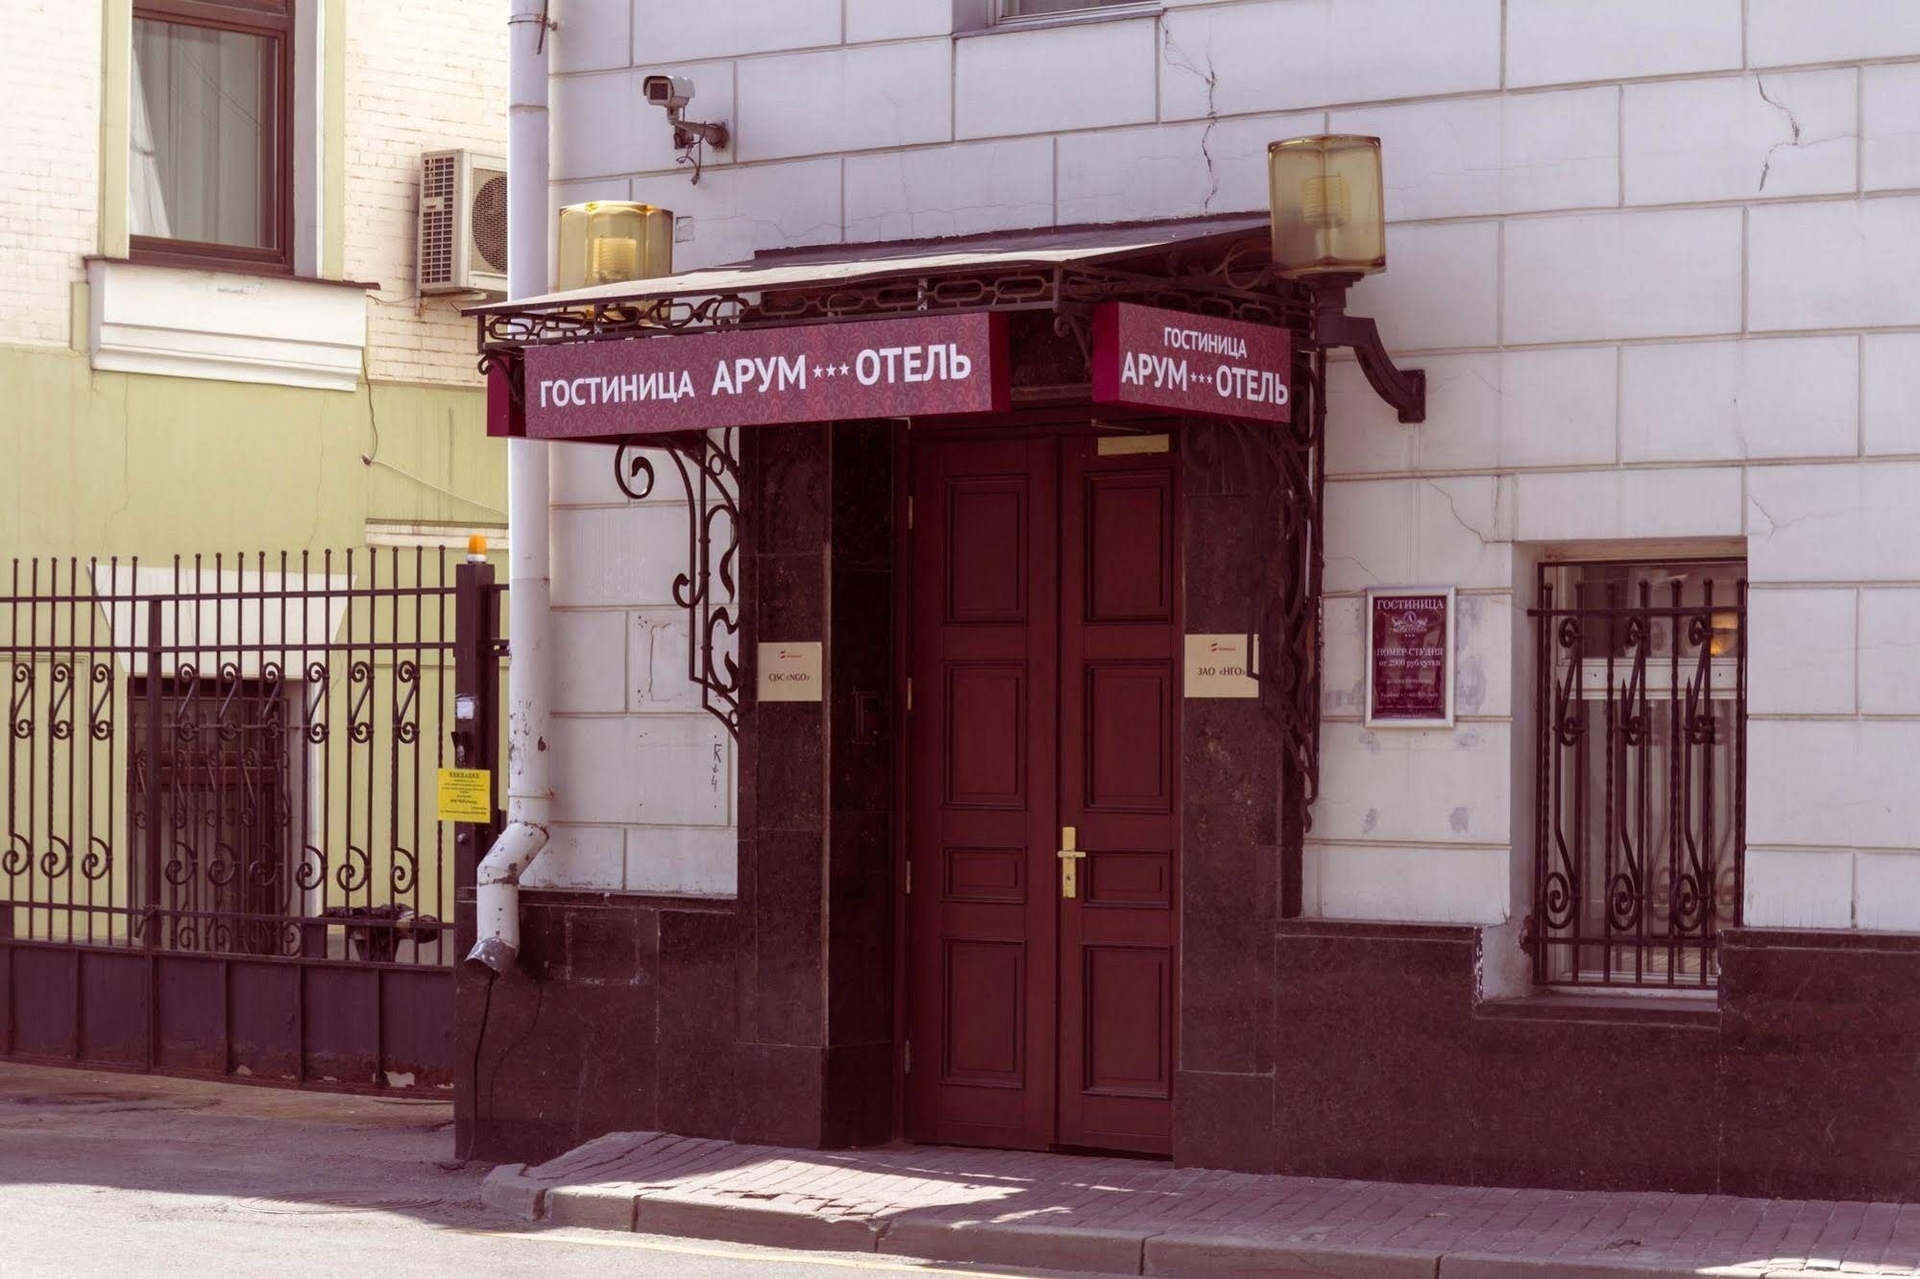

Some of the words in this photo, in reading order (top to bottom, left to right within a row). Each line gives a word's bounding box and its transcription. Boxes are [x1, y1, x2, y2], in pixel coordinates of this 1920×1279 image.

[1164, 327, 1247, 359] ГОСТИНИЦА
[540, 370, 695, 408] ГОСТИНИЦА
[711, 355, 806, 396] АРУМ
[855, 343, 971, 386] ОТЕЛЬ
[1121, 351, 1187, 391] АРУМ
[1216, 365, 1288, 405] ОТЕЛЬ
[1377, 599, 1444, 611] ГОСТИНИЦА
[1197, 667, 1216, 676] ЗАО
